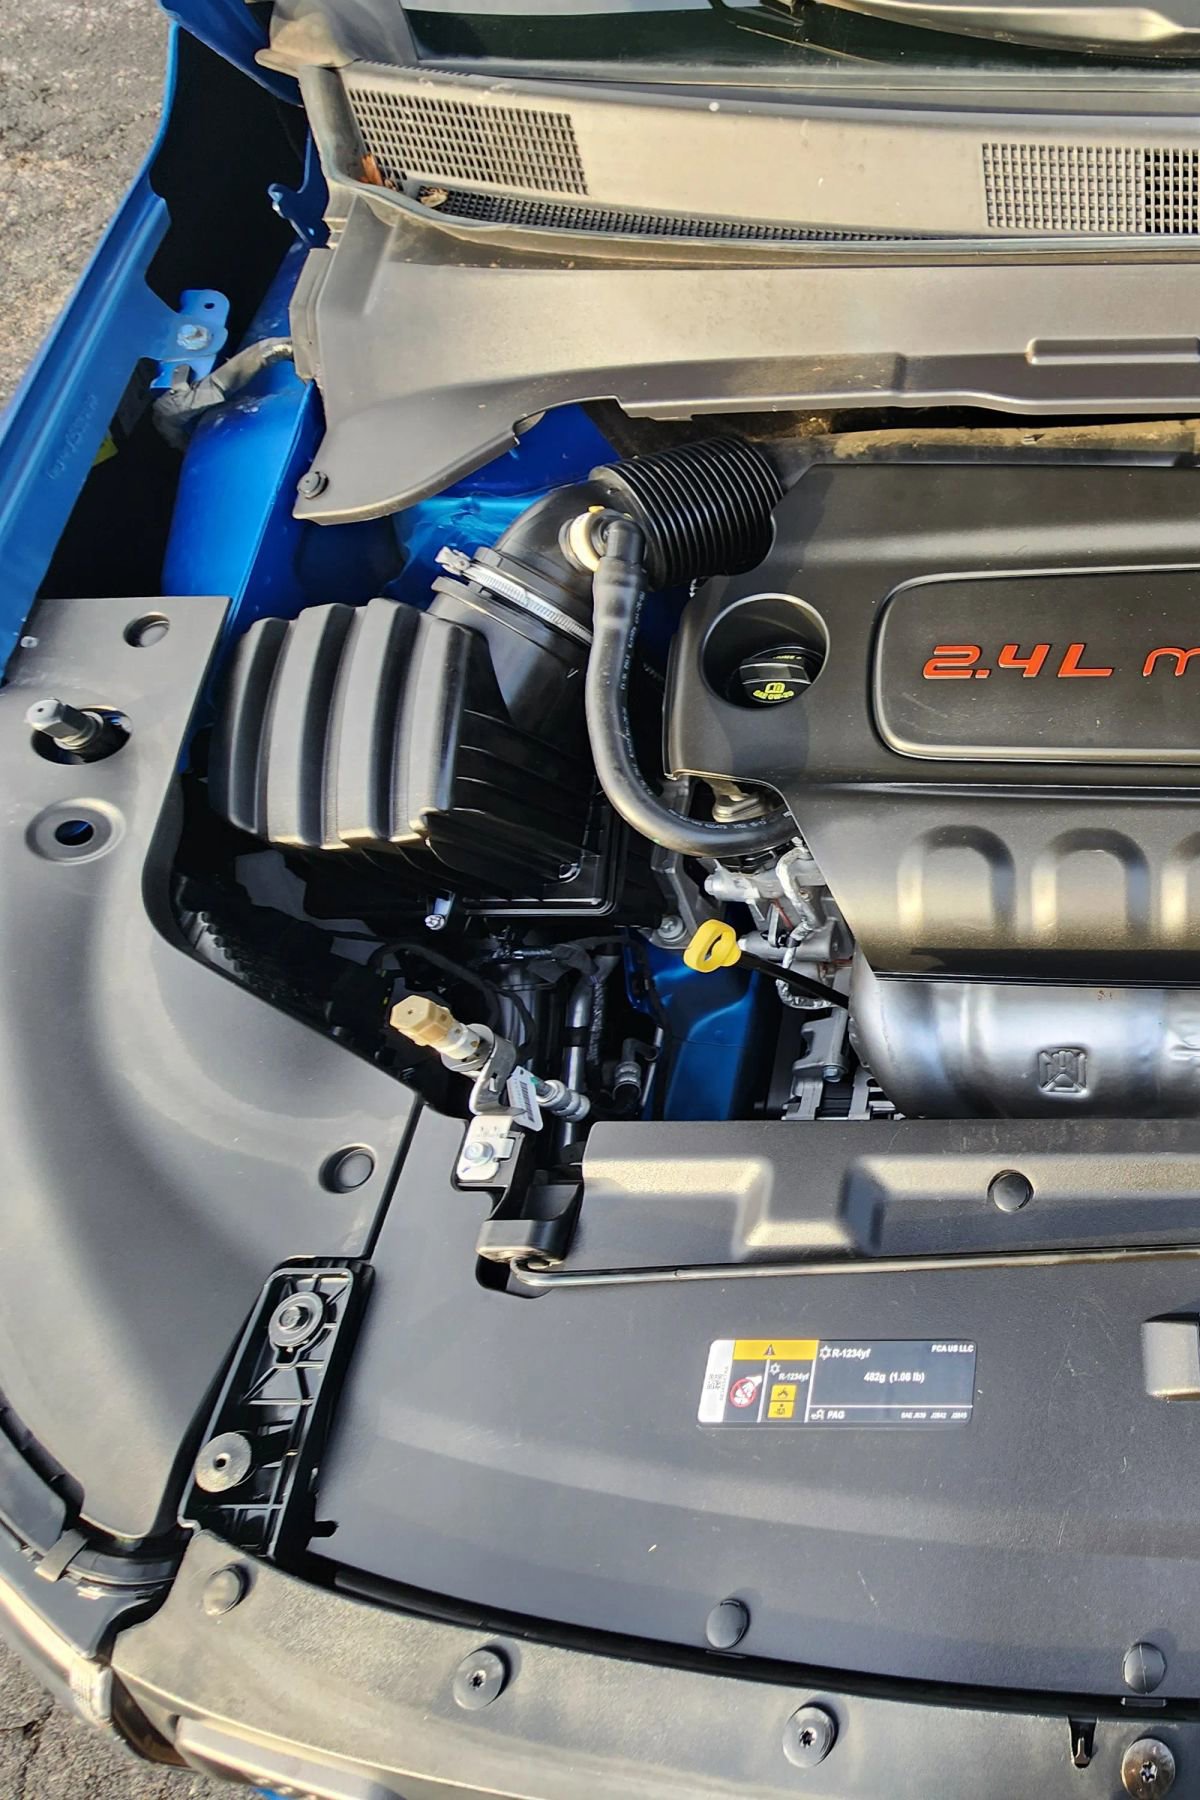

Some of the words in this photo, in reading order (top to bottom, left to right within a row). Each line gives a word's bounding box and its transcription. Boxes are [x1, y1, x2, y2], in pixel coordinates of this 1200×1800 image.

[931, 1344, 947, 1352] FCA
[948, 1344, 958, 1352] US
[959, 1344, 974, 1352] LLC
[832, 1348, 871, 1360] R-1234yf
[827, 1410, 845, 1419] PAG
